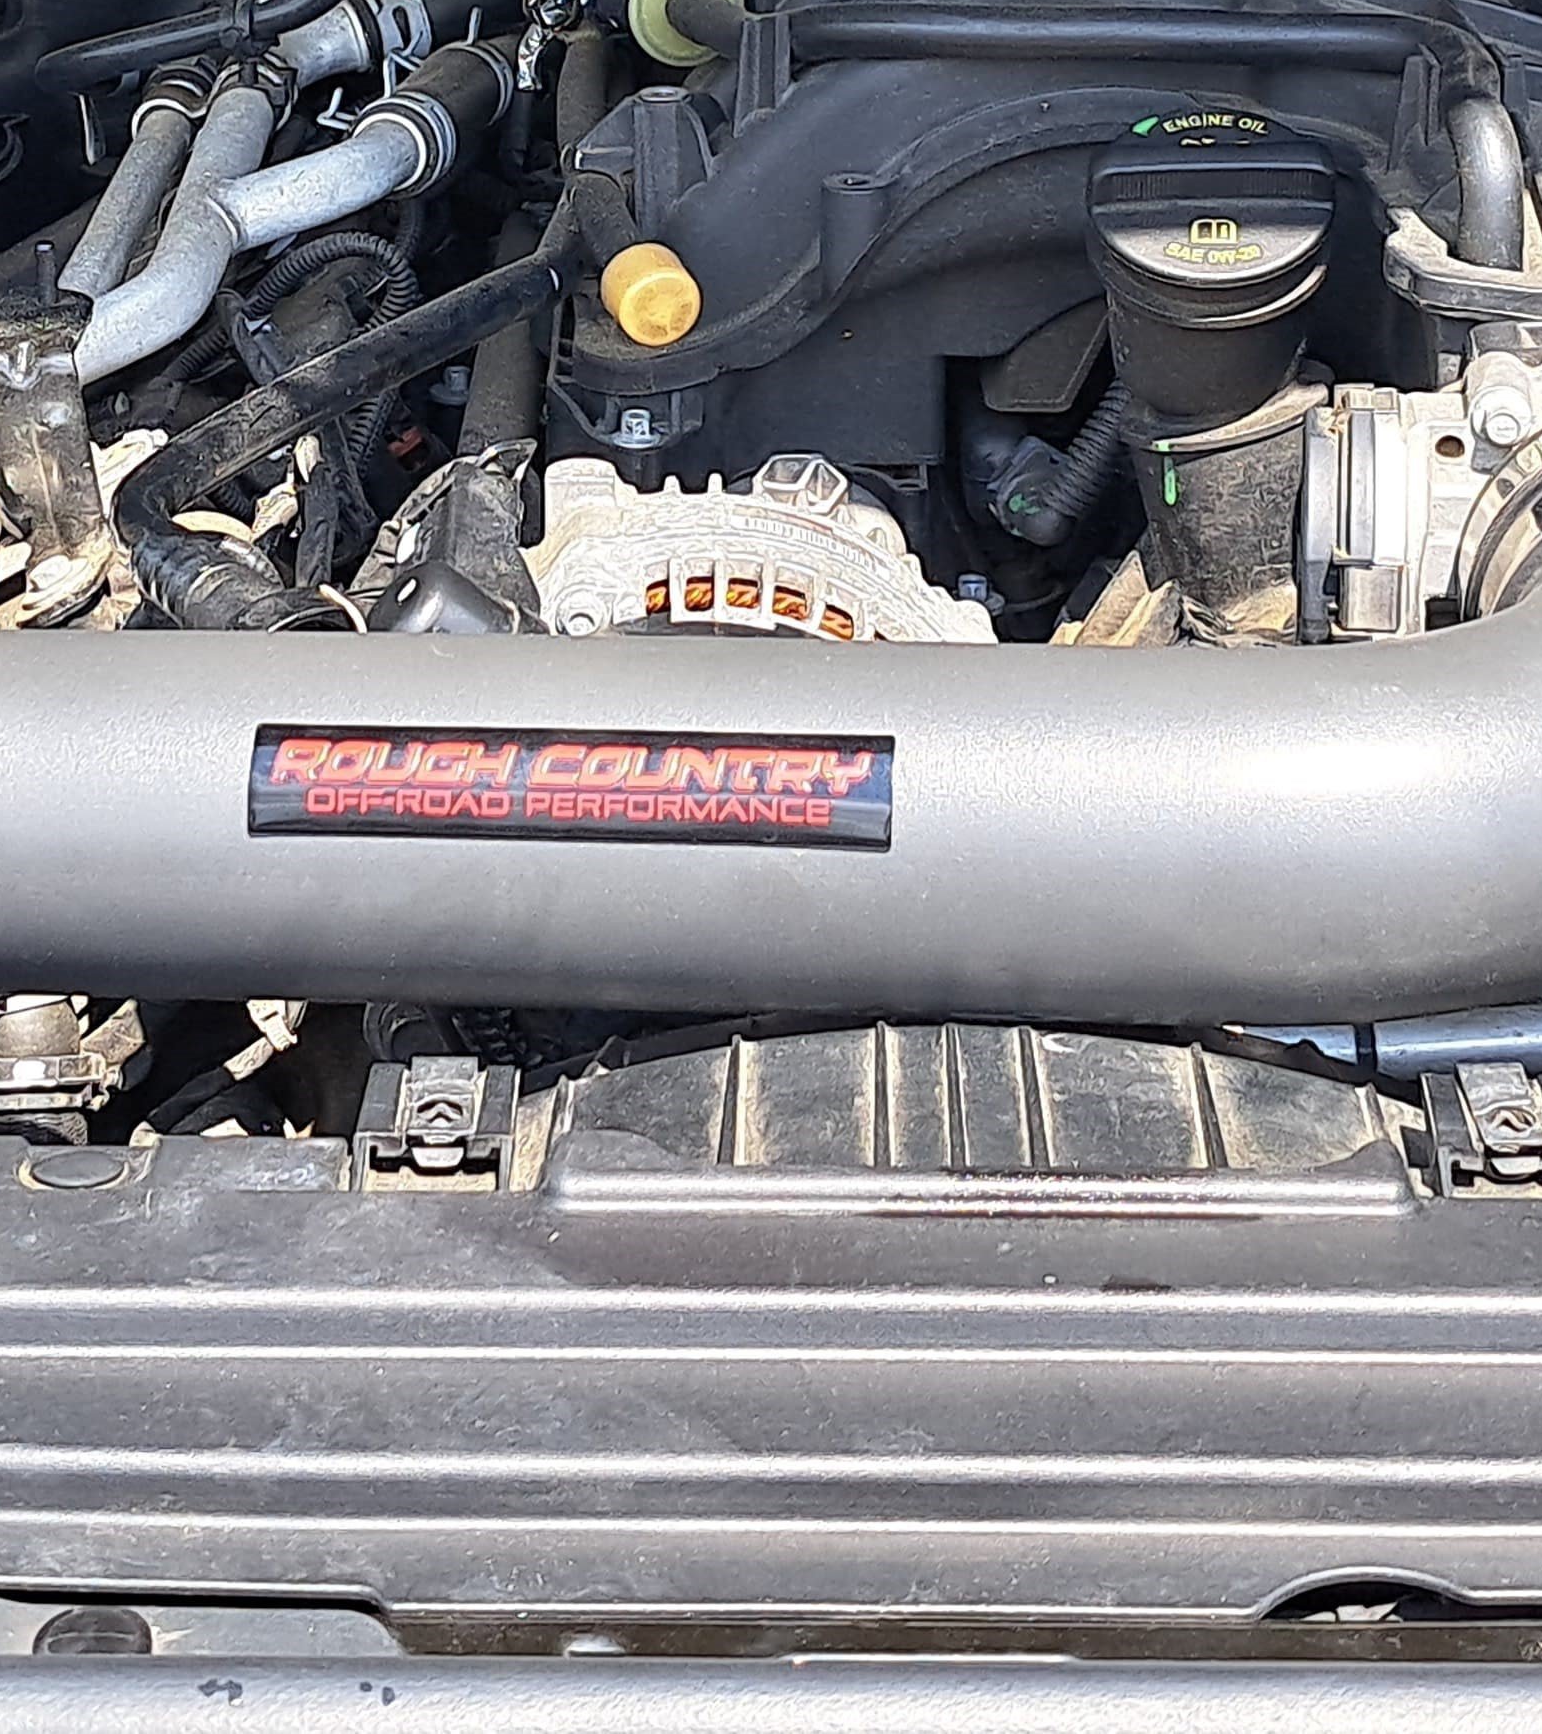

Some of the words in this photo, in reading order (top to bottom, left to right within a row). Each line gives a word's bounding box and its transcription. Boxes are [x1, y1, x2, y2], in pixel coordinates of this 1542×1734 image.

[1162, 113, 1233, 134] ENGINE
[1238, 116, 1268, 135] OIL
[1165, 241, 1203, 263] SAE
[270, 737, 521, 786] ROUGH
[525, 743, 875, 796] COUNTRY
[305, 787, 511, 816] OFF-ROAD
[526, 792, 832, 826] PERFORMANCE
